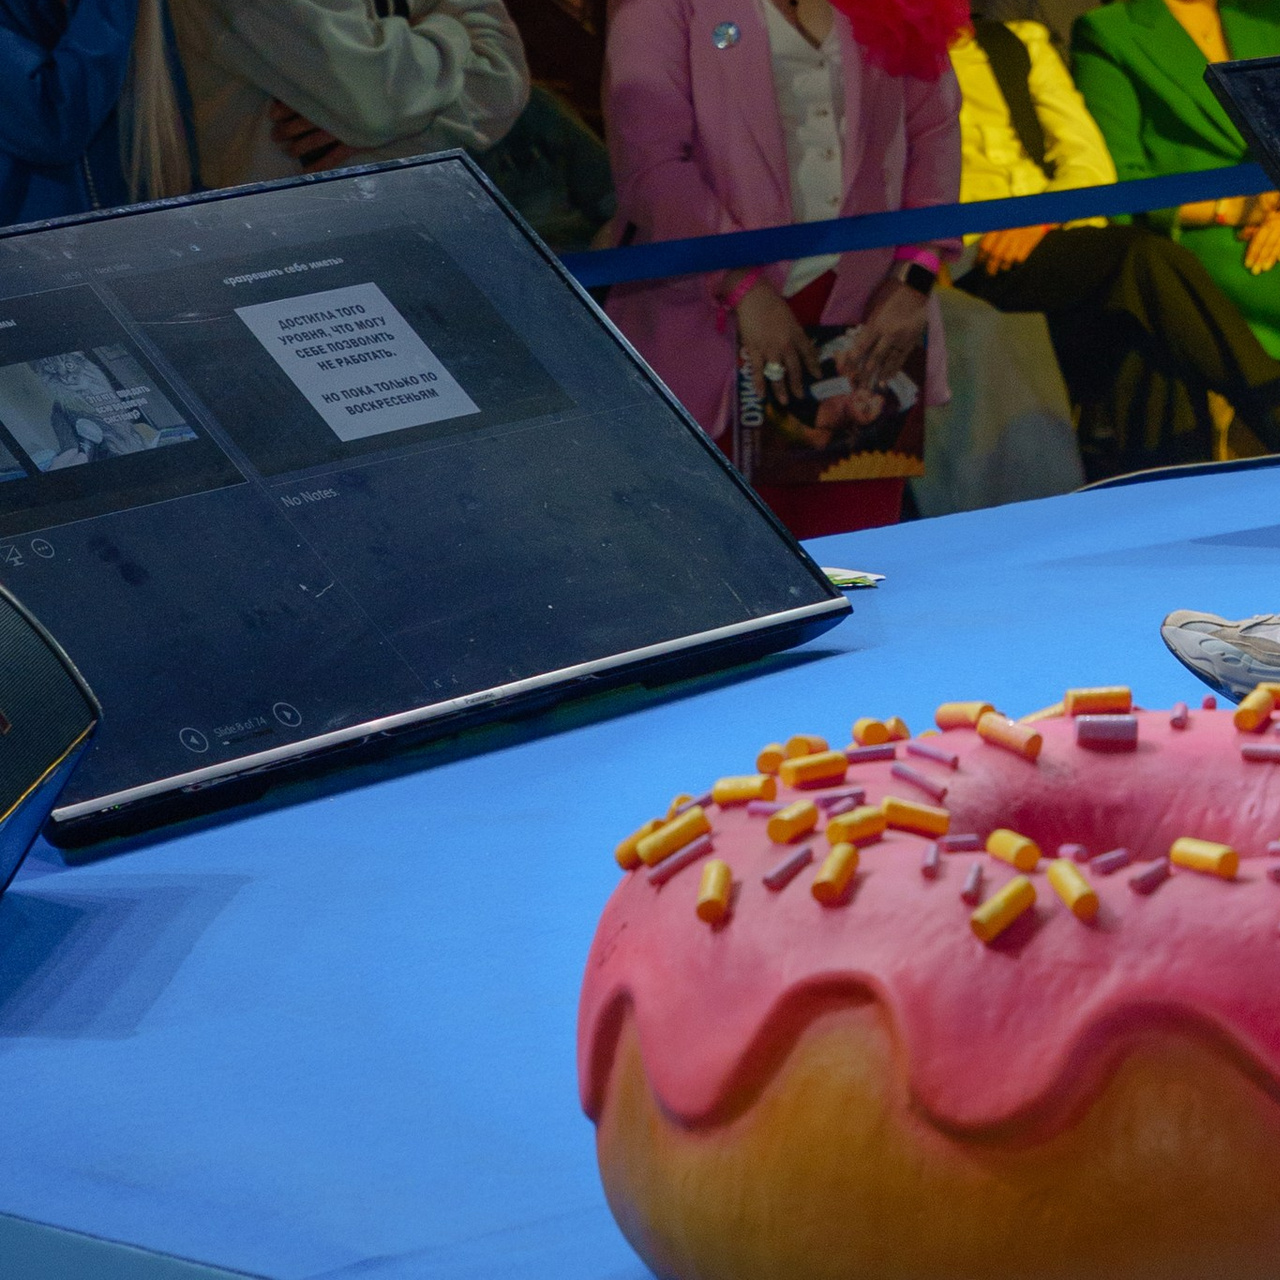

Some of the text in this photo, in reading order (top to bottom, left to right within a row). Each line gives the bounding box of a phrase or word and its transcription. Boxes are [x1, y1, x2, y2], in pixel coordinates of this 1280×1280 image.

[284, 262, 308, 275] себе
[278, 304, 366, 331] ДОСТИГЛА ТОГО
[278, 316, 386, 345] УРОВНЯ, ЧТО МОГУ
[295, 332, 395, 359] СЕБЕ ПОЗВОЛИТЬ
[317, 358, 335, 372] НЕ
[321, 371, 438, 404] НО ПОКА ТОЛЬКО ПО
[345, 388, 439, 416] ВОСКРЕСЕНЬЯМ
[280, 495, 302, 508] No
[213, 725, 236, 738] Slide
